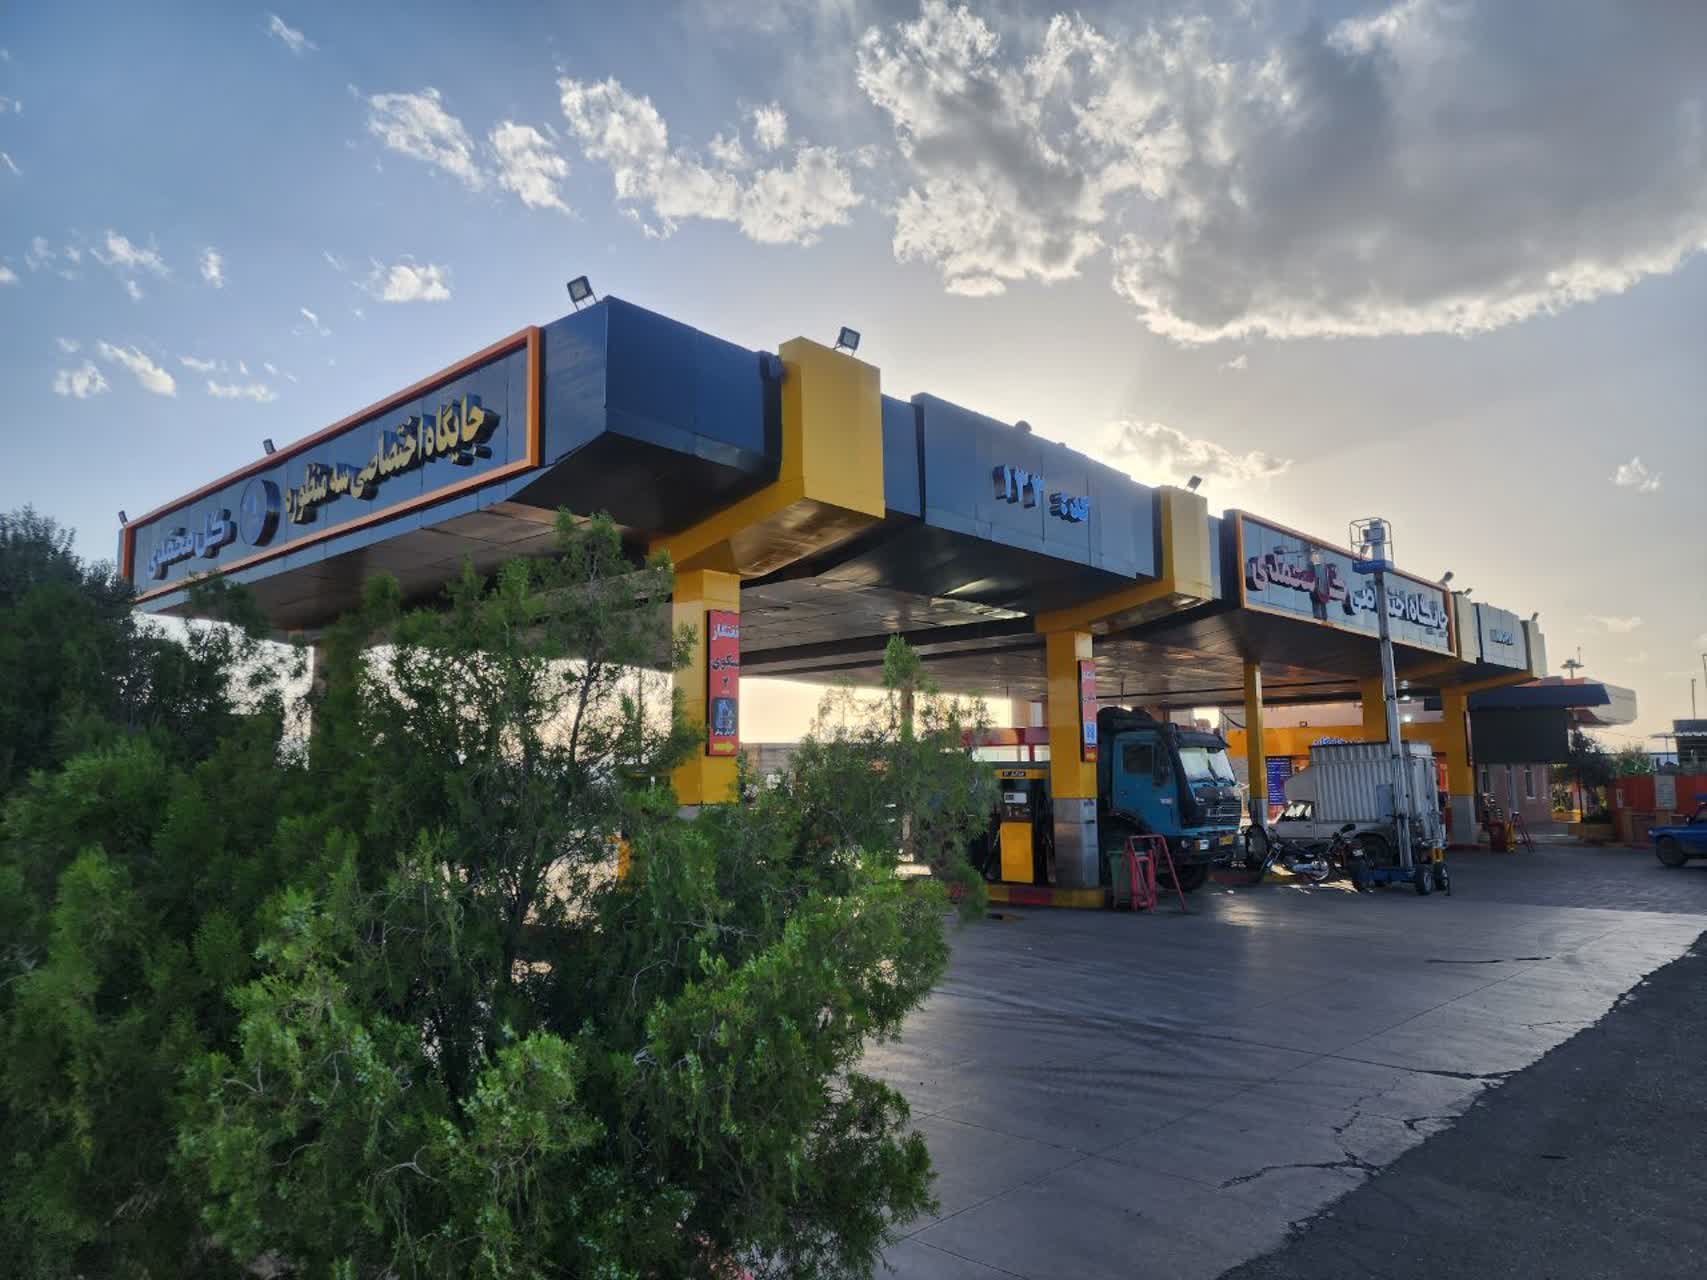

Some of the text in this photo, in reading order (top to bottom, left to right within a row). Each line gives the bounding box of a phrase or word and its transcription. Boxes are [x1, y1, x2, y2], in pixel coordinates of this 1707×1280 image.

[351, 415, 424, 498] اختصاصی
[427, 393, 487, 465] جایگاه
[1351, 585, 1409, 620] اختصی
[1409, 593, 1448, 637] جایگاه
